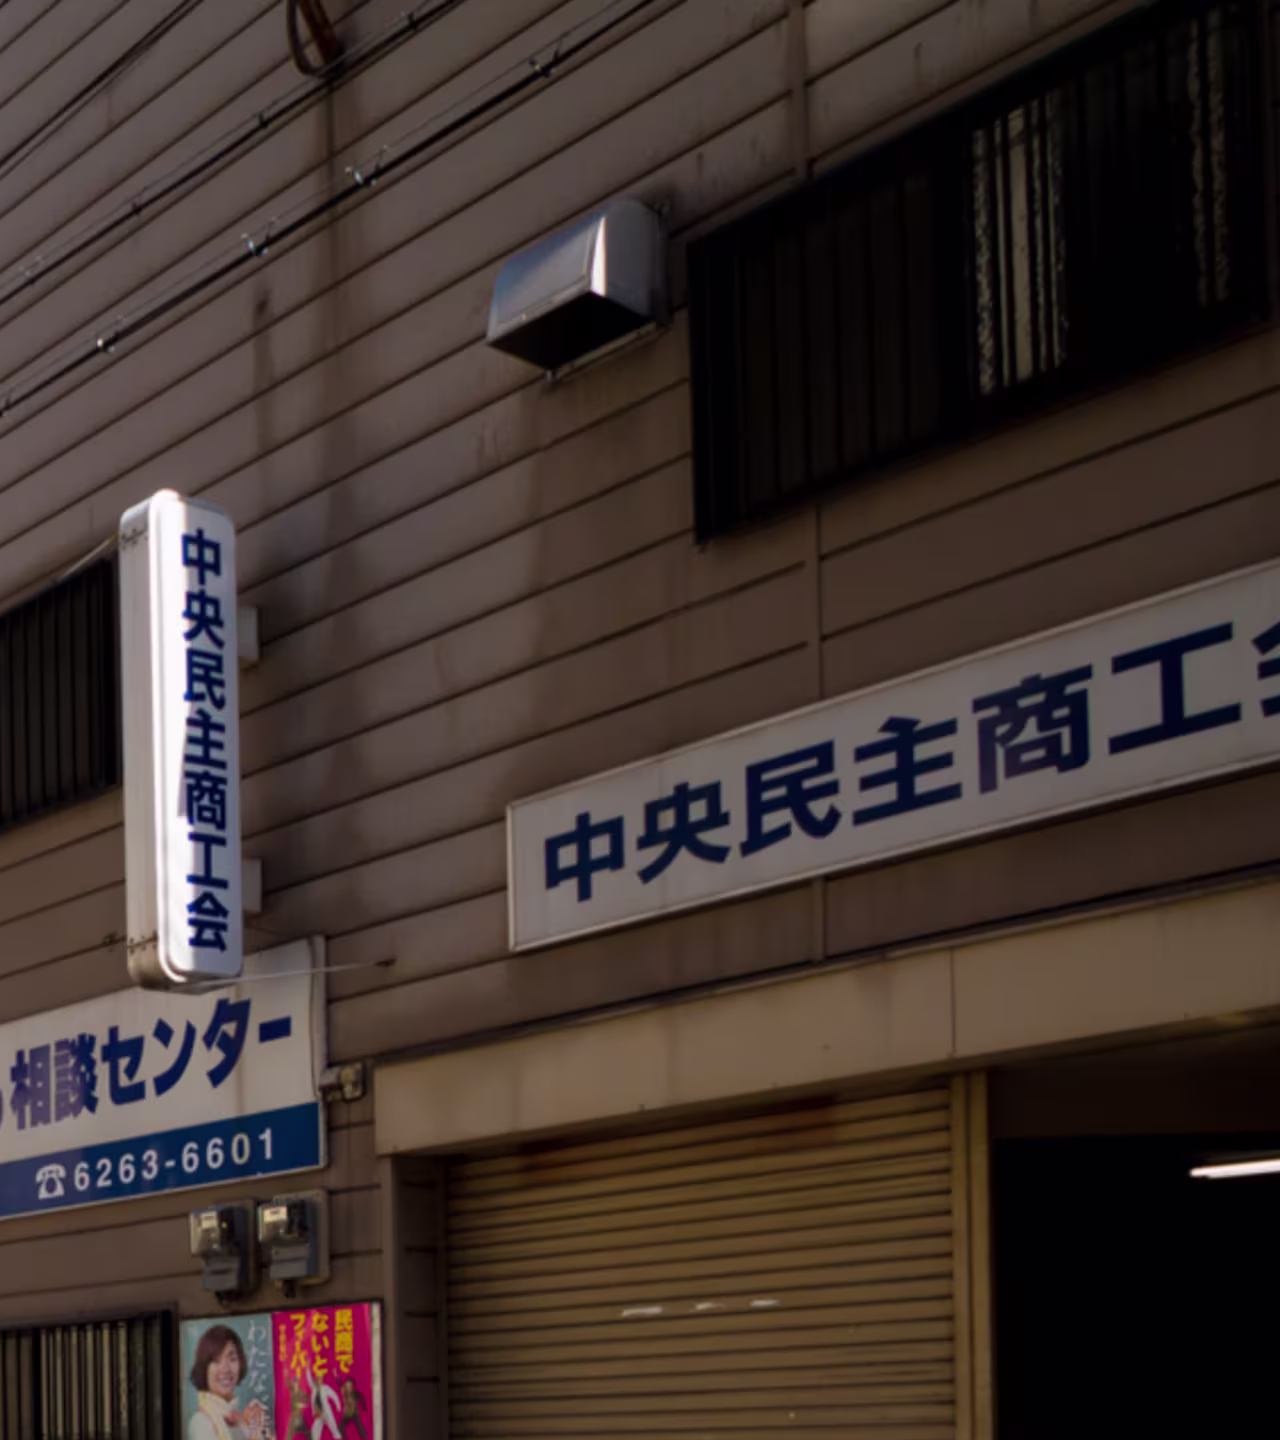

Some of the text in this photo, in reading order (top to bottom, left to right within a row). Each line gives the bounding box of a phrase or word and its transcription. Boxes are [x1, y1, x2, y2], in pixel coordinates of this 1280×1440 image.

[181, 529, 229, 952] 中央民主商工会
[544, 620, 1280, 903] 中央民主商工
[73, 1128, 276, 1192] 6263-6601
